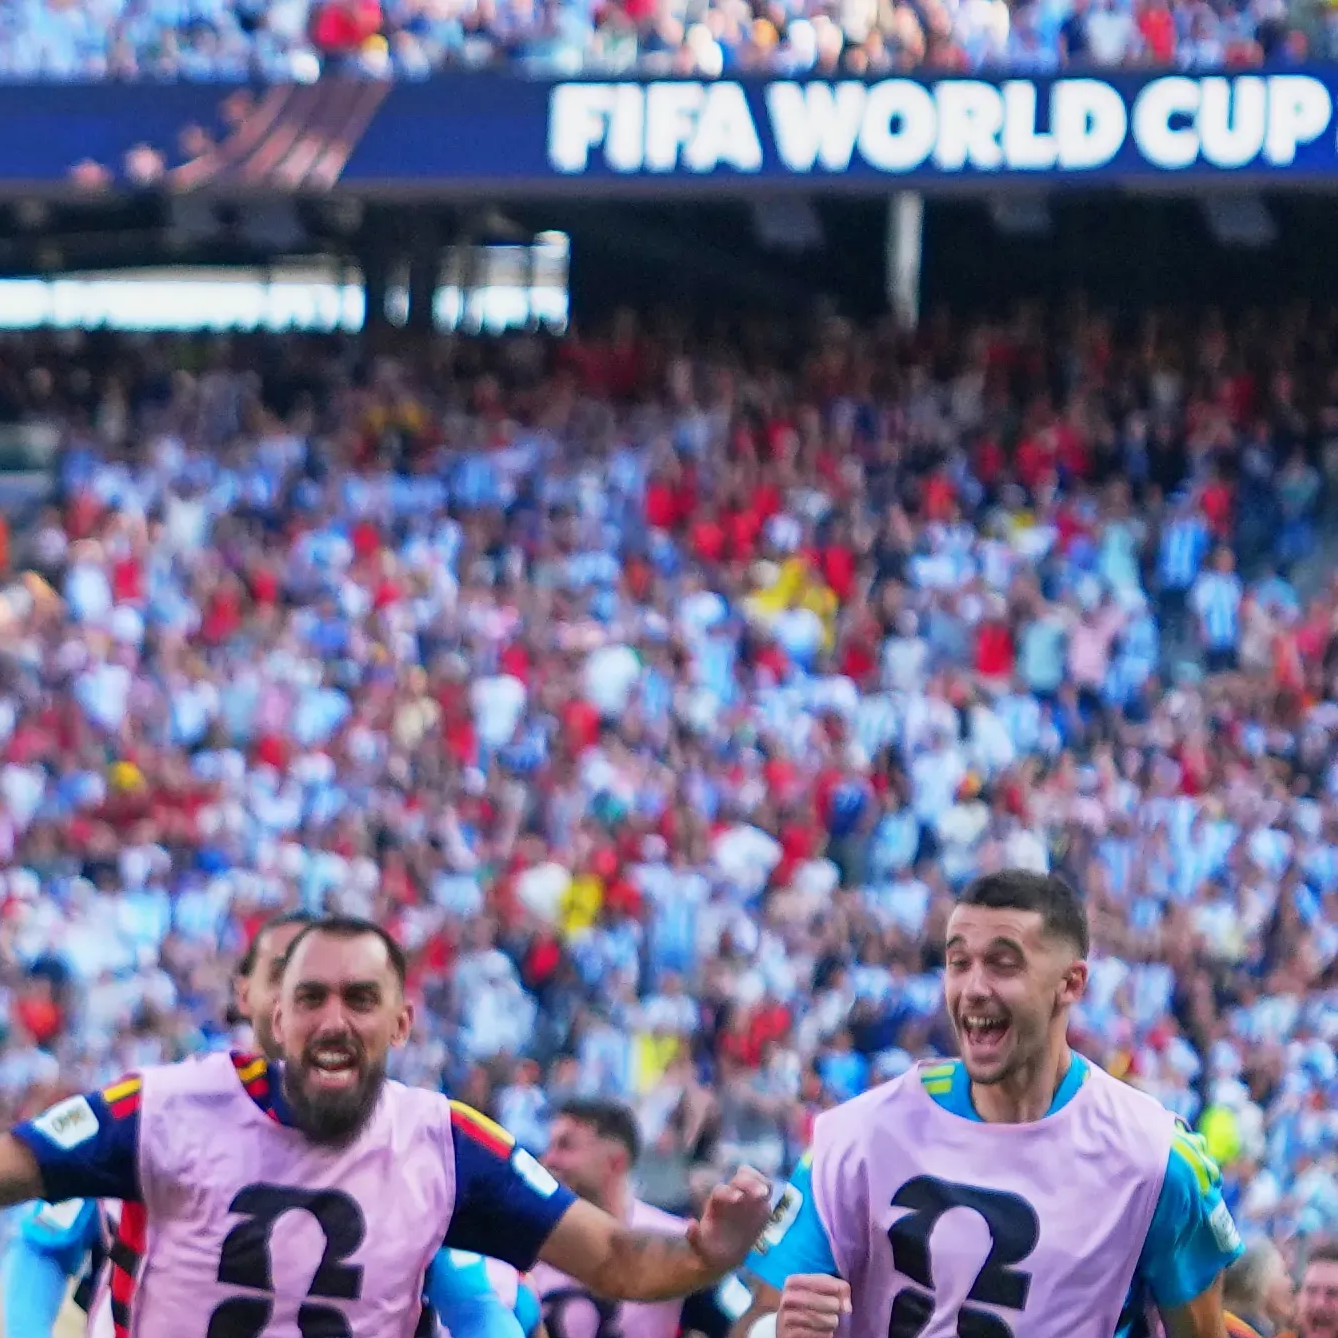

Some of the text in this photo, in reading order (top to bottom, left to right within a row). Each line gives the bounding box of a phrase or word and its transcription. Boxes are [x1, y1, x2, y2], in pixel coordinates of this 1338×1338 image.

[548, 74, 1332, 171] FIFA WORLD CUP
